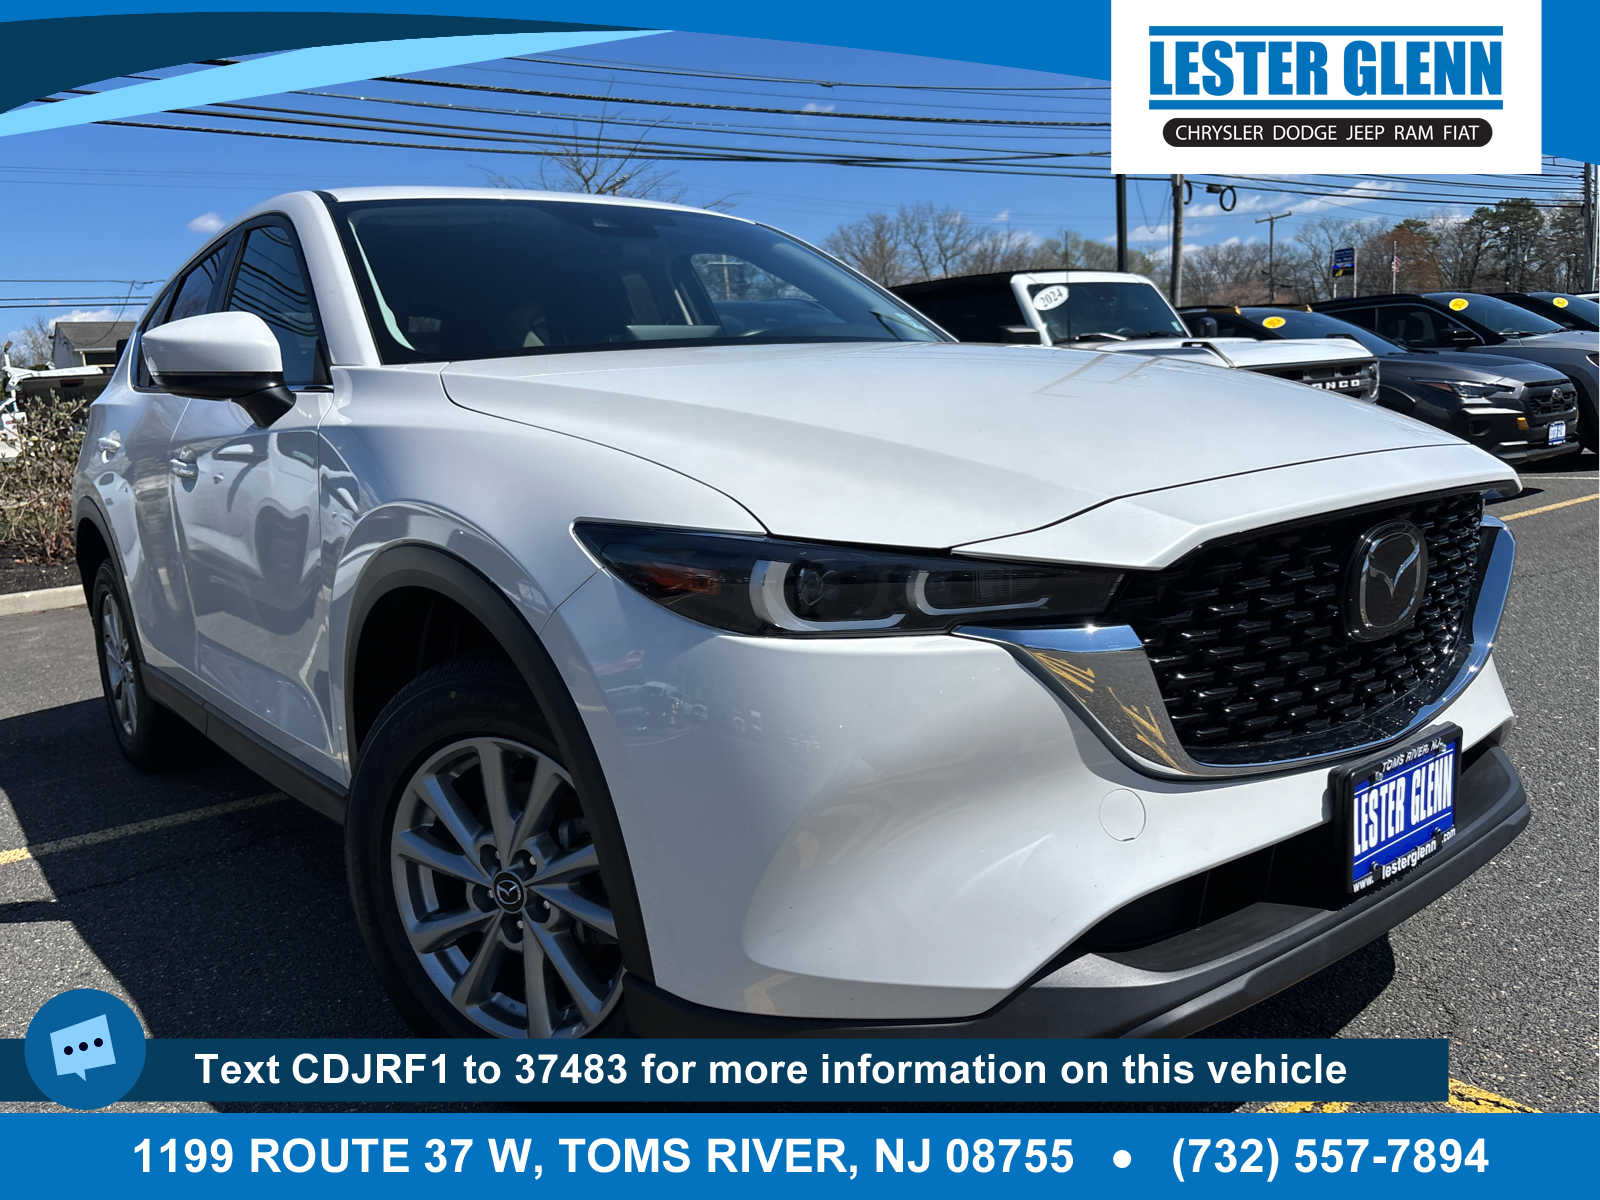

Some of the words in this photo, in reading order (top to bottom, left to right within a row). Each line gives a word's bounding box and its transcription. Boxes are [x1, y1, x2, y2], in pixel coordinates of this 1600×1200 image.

[1039, 287, 1064, 308] 2024
[1311, 379, 1361, 390] ONCO
[1382, 754, 1405, 773] TOMS
[1353, 776, 1406, 858] LESTER
[1411, 753, 1454, 826] GLENN
